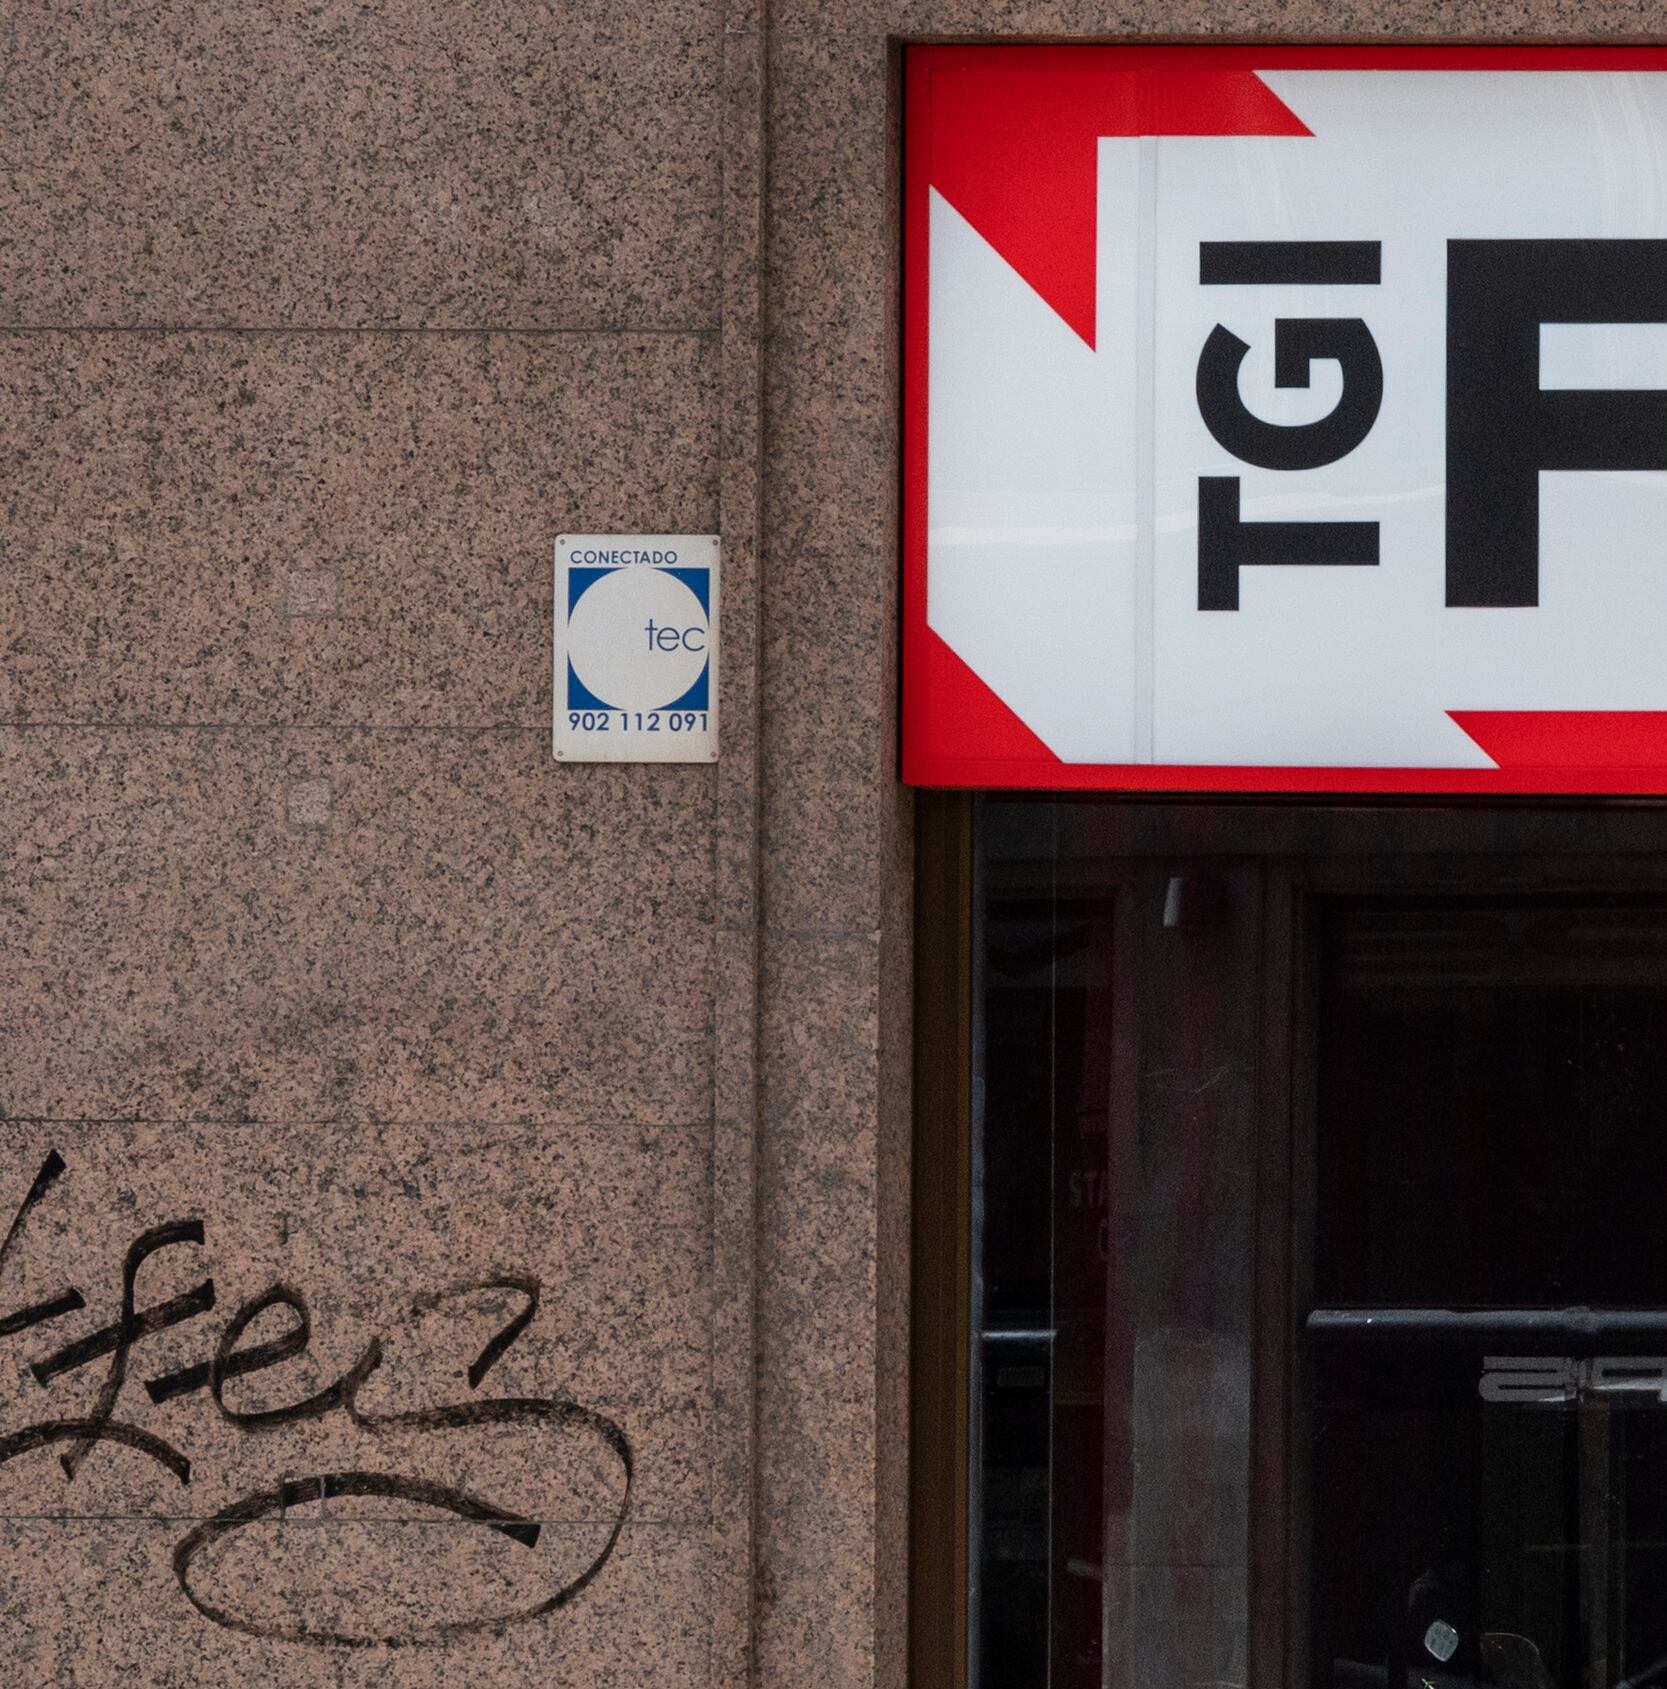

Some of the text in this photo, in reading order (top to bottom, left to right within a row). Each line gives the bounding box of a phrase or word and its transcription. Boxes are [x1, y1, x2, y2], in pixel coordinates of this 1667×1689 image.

[1197, 240, 1383, 610] TGI
[570, 550, 678, 565] CONECTADO
[645, 618, 706, 651] tec
[568, 712, 709, 732] 902 112 091
